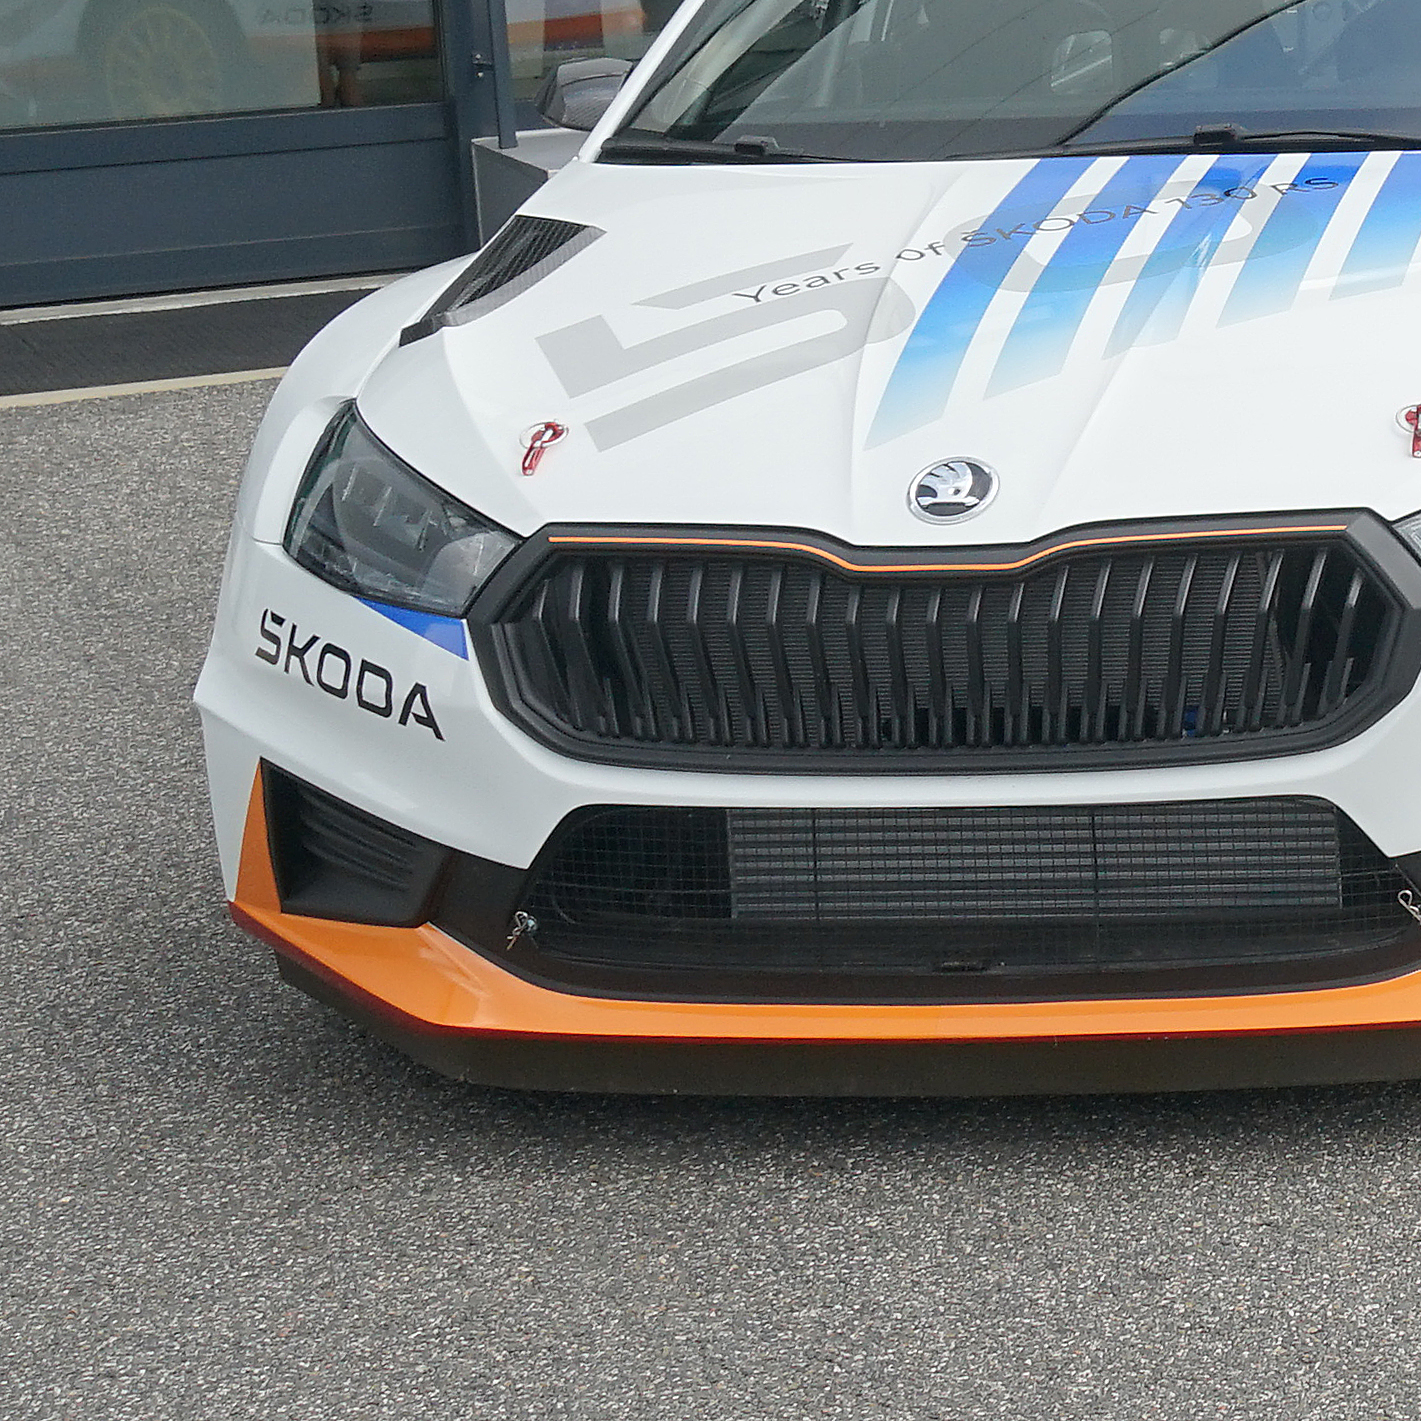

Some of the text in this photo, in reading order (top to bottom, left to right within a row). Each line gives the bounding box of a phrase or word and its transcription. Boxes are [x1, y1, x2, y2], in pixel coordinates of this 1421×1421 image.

[732, 261, 881, 304] Years
[1164, 185, 1258, 210] 130
[1270, 177, 1339, 196] RS
